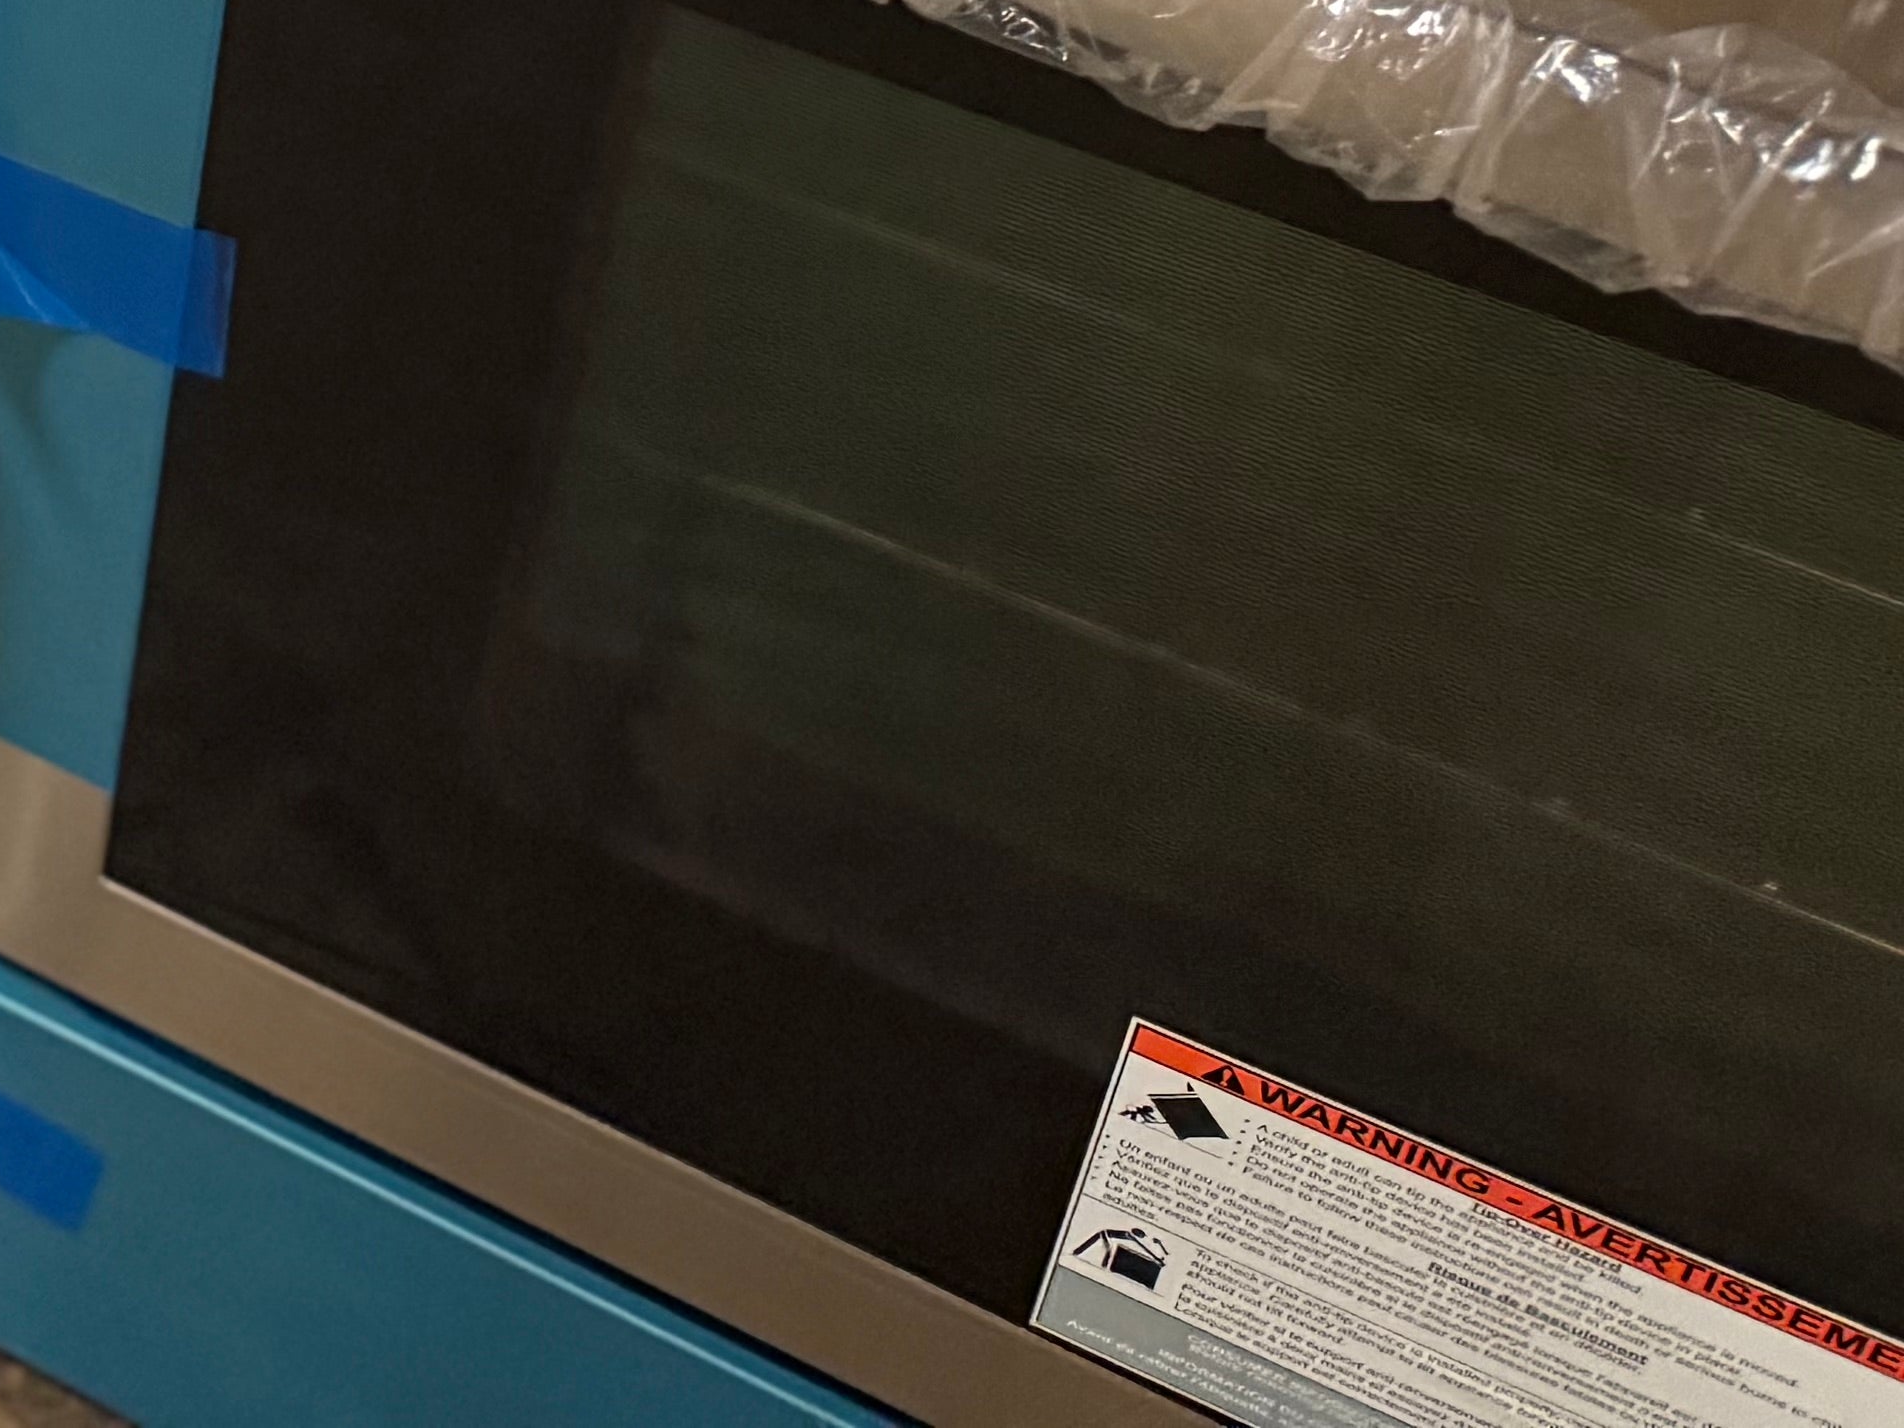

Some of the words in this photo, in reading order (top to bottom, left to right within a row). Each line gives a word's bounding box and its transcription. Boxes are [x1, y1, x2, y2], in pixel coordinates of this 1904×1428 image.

[1260, 1080, 1492, 1196] WARNING
[1532, 1203, 1904, 1378] AVERTISSEME
[1272, 1128, 1308, 1151] child
[1311, 1147, 1328, 1160] or
[1330, 1154, 1369, 1177] adult
[1372, 1173, 1402, 1192] can
[1404, 1185, 1425, 1204] tip
[1429, 1196, 1455, 1214] the
[1456, 1208, 1535, 1250] appliance
[1537, 1243, 1570, 1264] and
[1573, 1258, 1594, 1275] be
[1555, 1237, 1622, 1273] Hazard
[1427, 1260, 1493, 1298] Risque
[1496, 1290, 1522, 1310] de
[1523, 1303, 1649, 1366] Basculement
